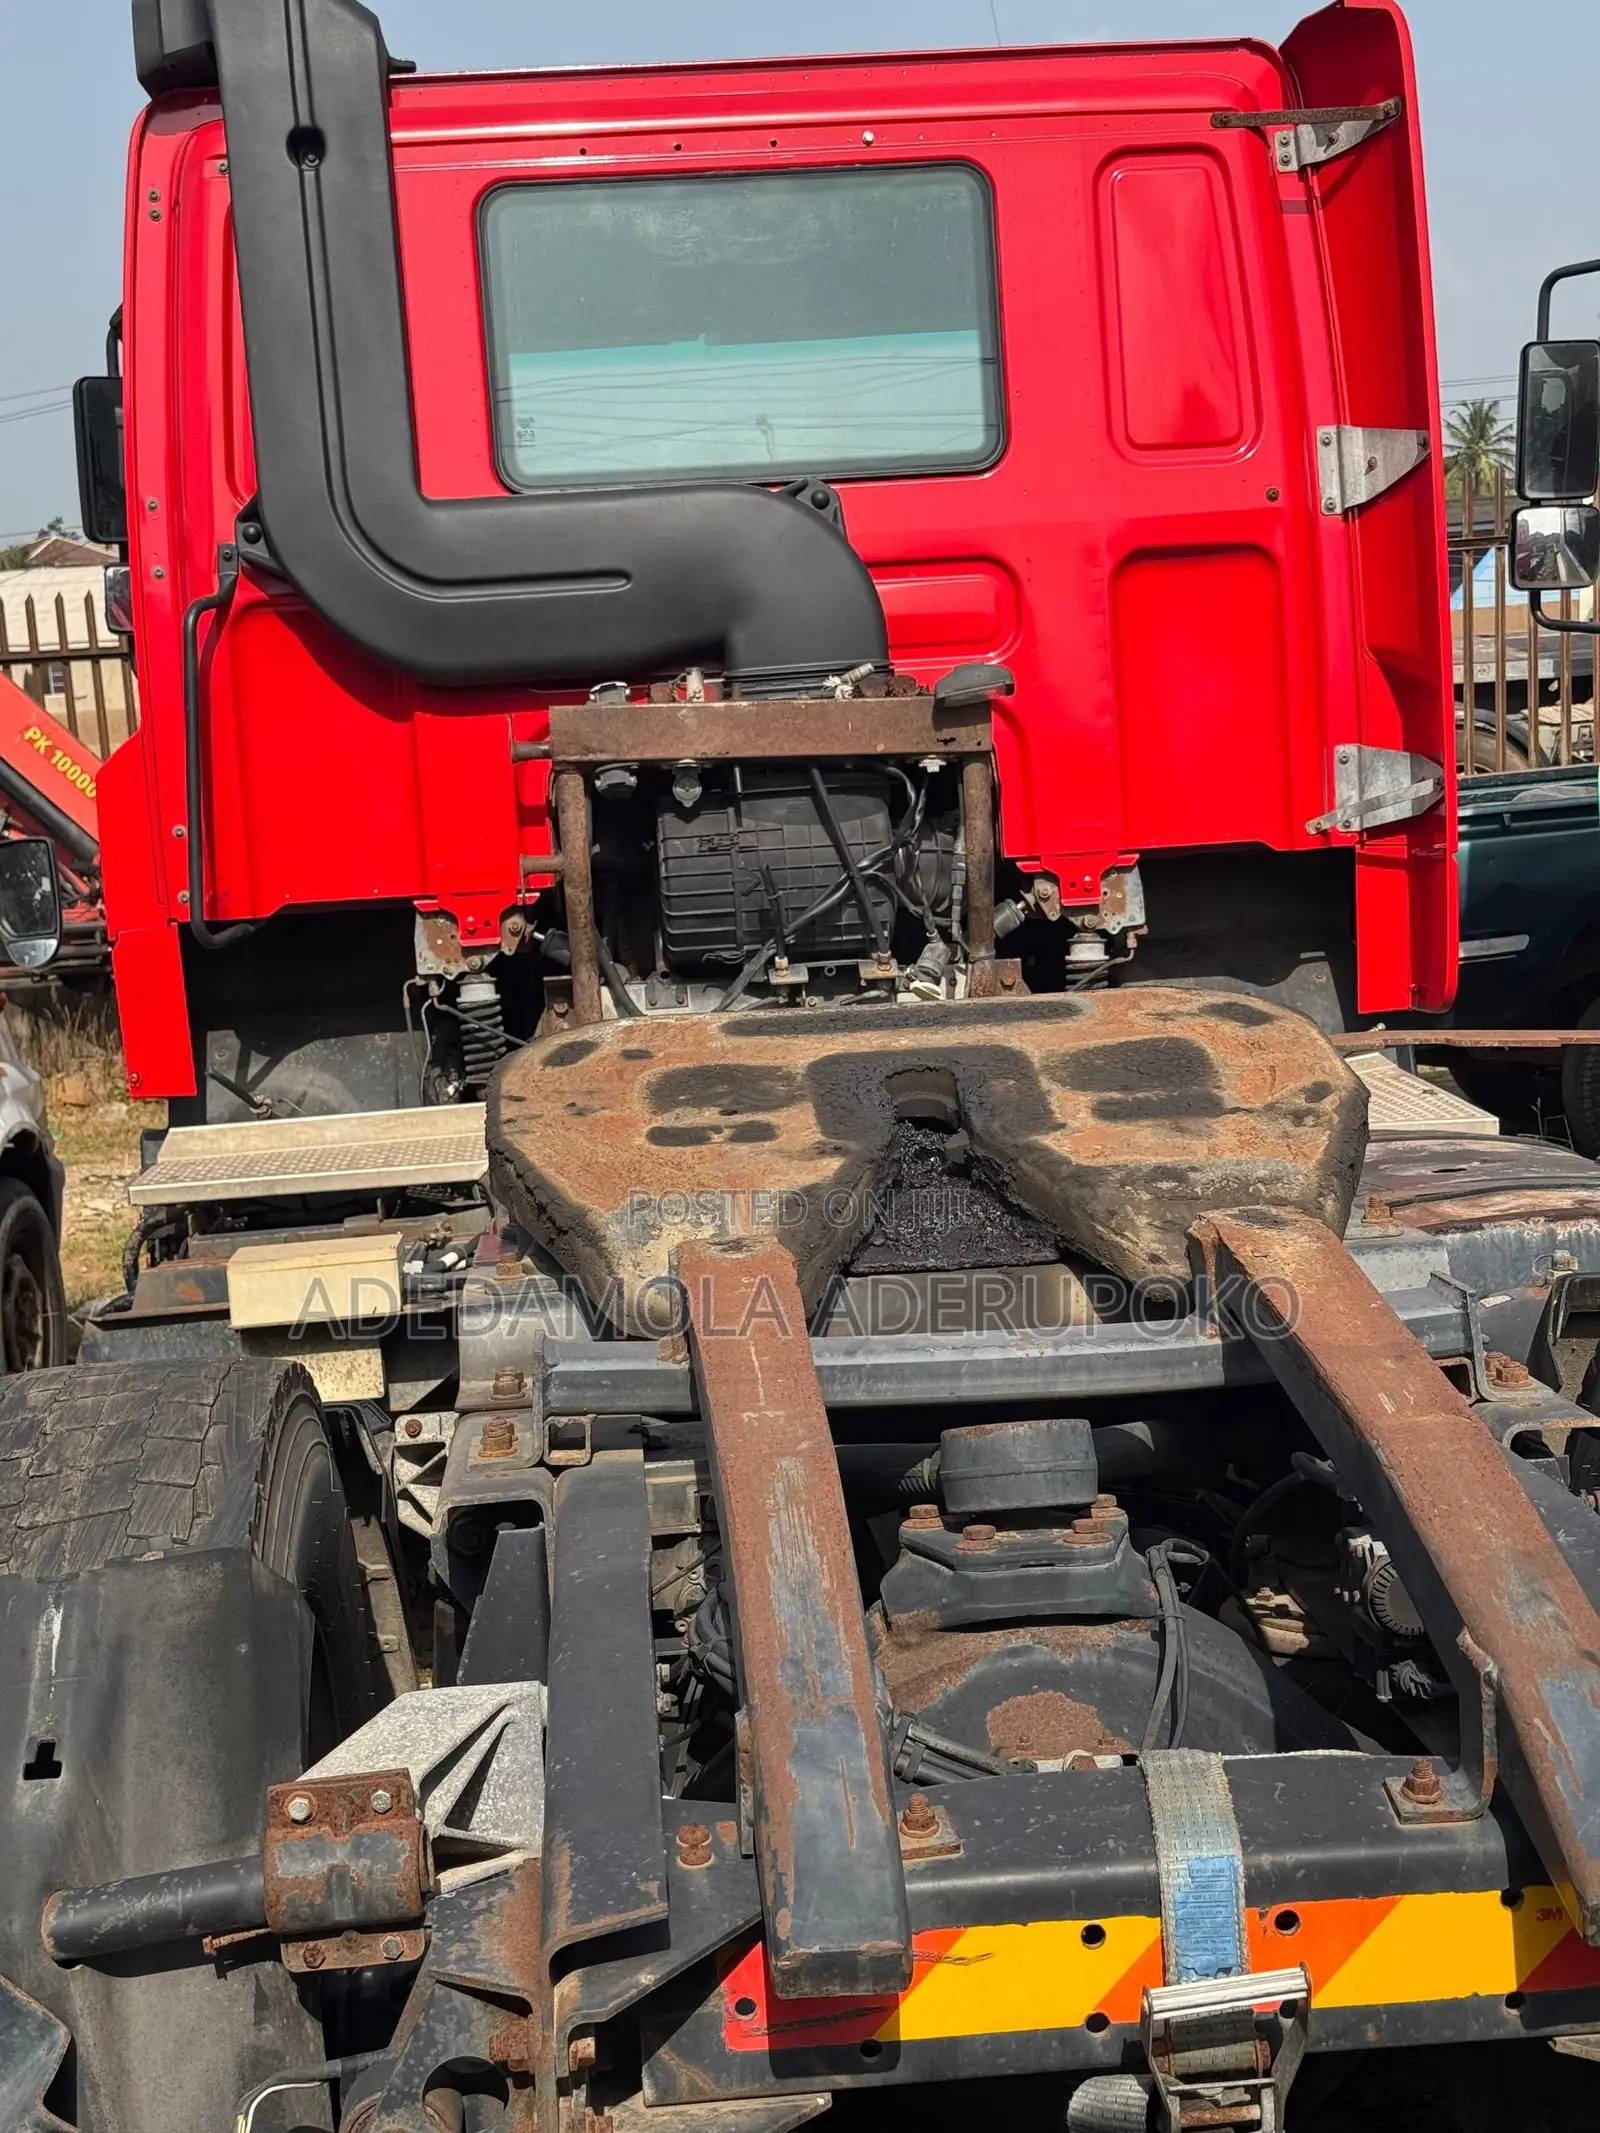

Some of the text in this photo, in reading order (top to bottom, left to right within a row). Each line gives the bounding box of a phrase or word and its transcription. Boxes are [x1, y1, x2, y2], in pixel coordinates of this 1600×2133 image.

[23, 726, 97, 798] PK 10000
[1535, 1906, 1563, 1922] 3M
